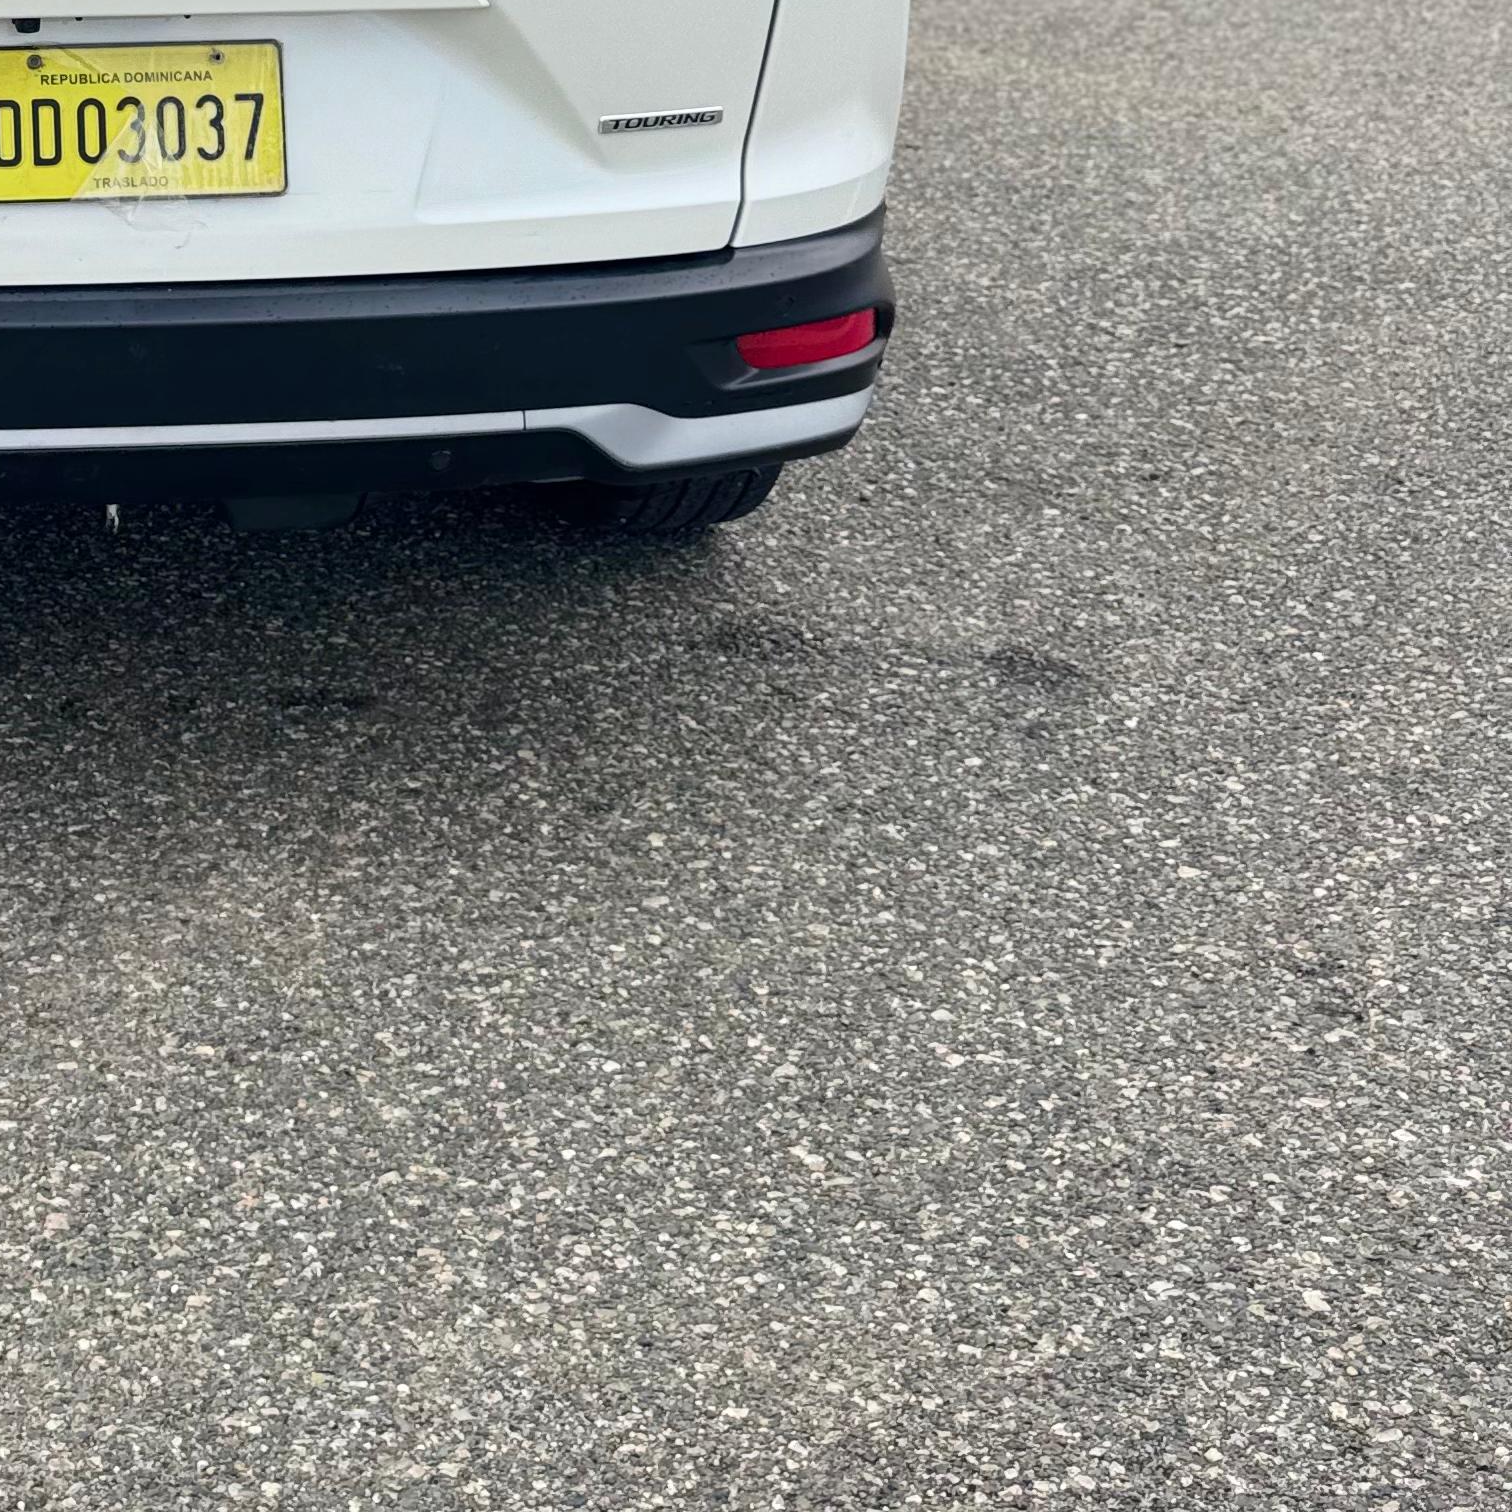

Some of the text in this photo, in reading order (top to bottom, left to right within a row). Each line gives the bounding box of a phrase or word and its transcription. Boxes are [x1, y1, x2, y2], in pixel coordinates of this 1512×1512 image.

[39, 70, 214, 87] REPUBLICA DOMINICANA
[609, 111, 716, 130] TOURING
[92, 175, 170, 190] TRASLADO
